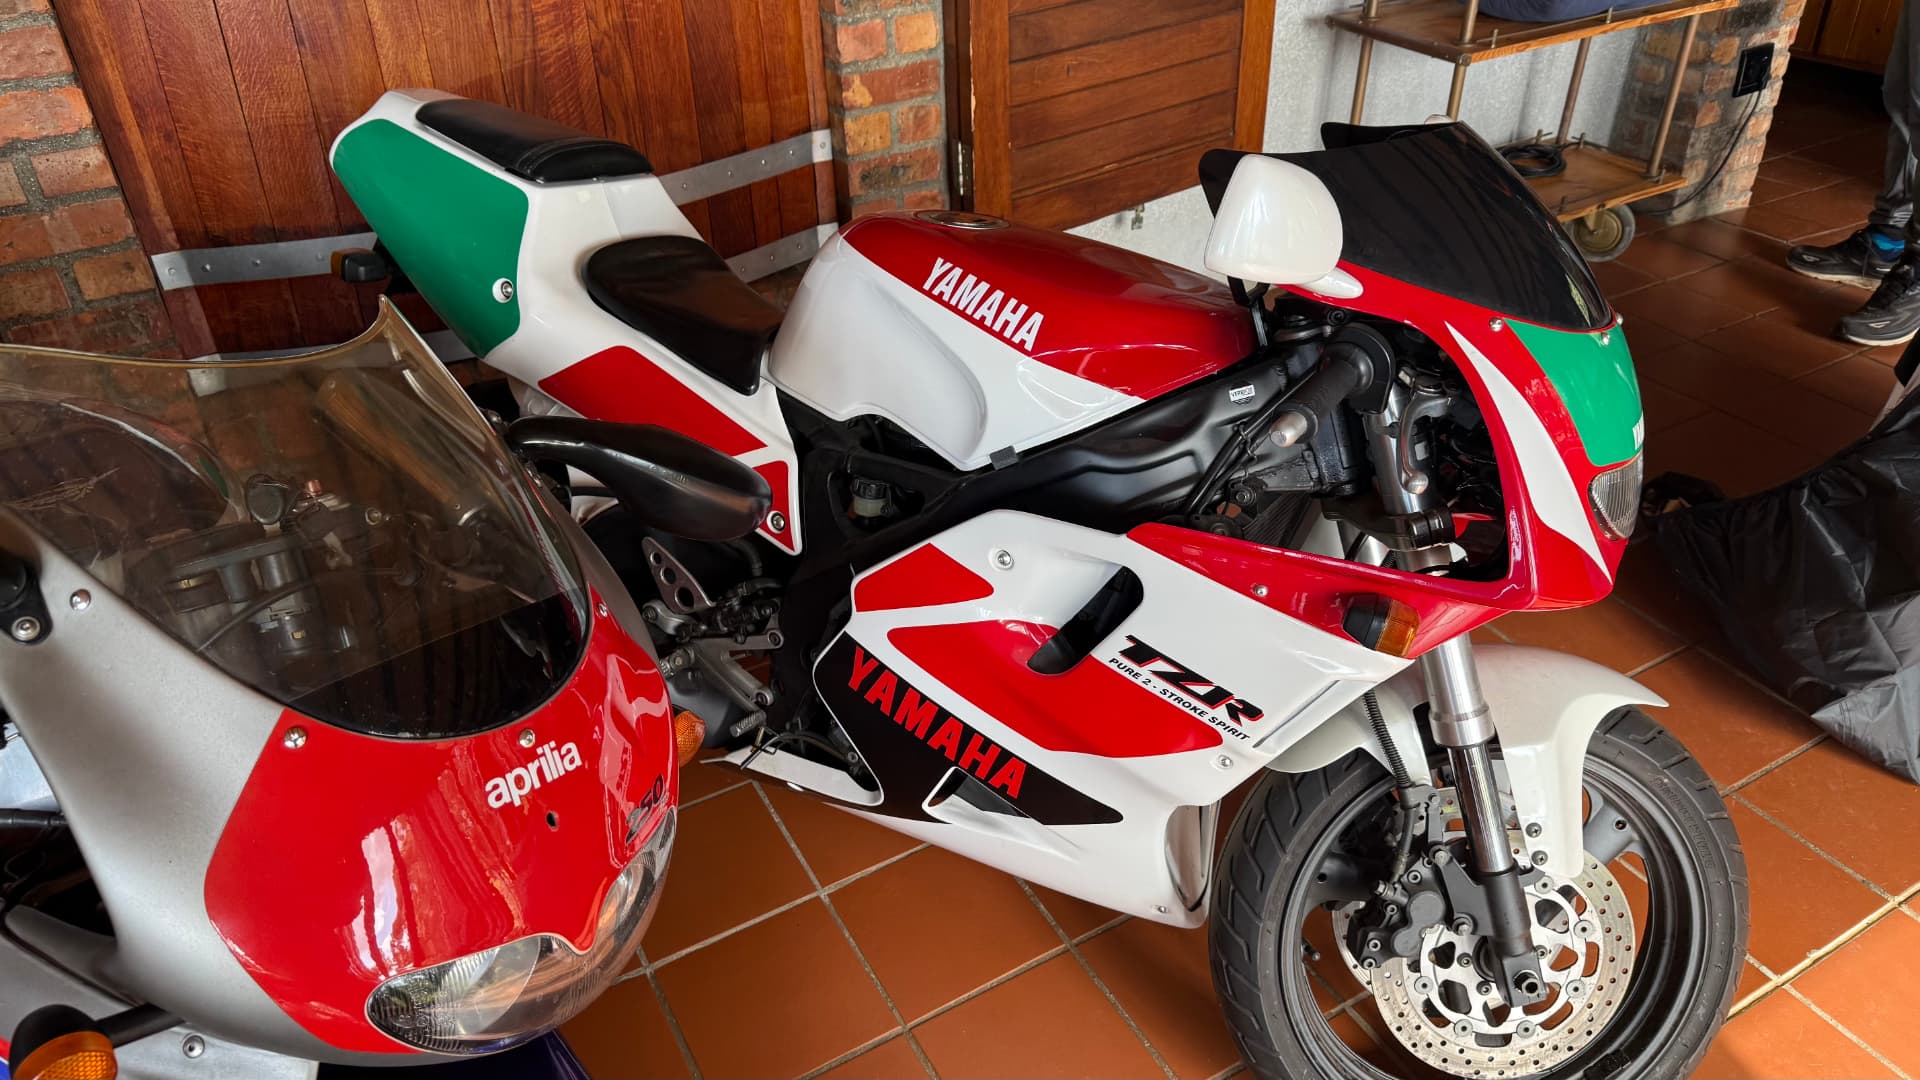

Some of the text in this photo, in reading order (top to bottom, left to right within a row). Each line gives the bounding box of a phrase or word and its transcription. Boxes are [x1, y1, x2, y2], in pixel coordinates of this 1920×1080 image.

[923, 257, 1044, 352] YAMAHA
[848, 645, 1027, 799] YAMAHA
[1109, 657, 1142, 680] PURE
[1159, 688, 1208, 718] STROKE
[1208, 716, 1251, 741] SPIRIT
[1118, 634, 1264, 727] TZR
[485, 740, 583, 809] aprilia
